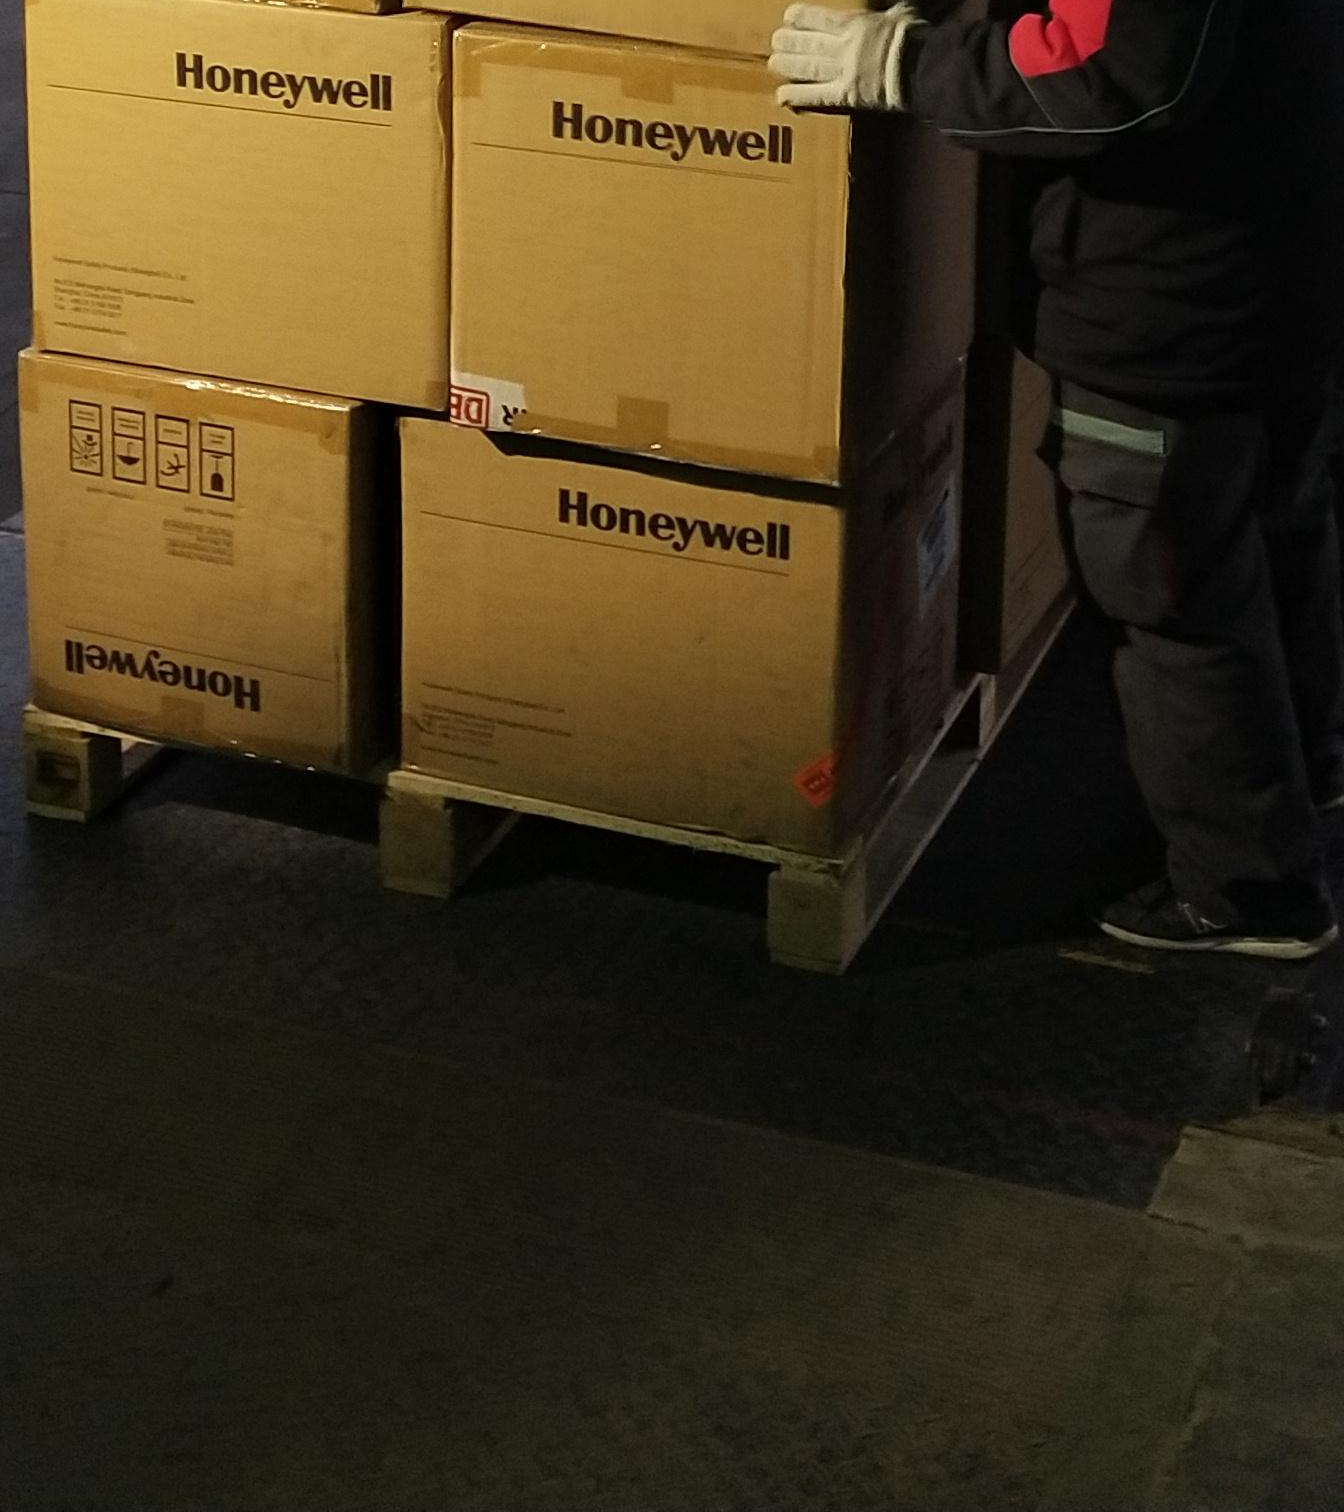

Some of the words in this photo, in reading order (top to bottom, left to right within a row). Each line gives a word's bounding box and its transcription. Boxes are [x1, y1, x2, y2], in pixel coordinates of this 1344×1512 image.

[175, 51, 393, 113] Honeywell
[551, 101, 794, 165] Honeywell
[558, 488, 791, 561] Honeywell
[64, 639, 261, 713] Honeywell
